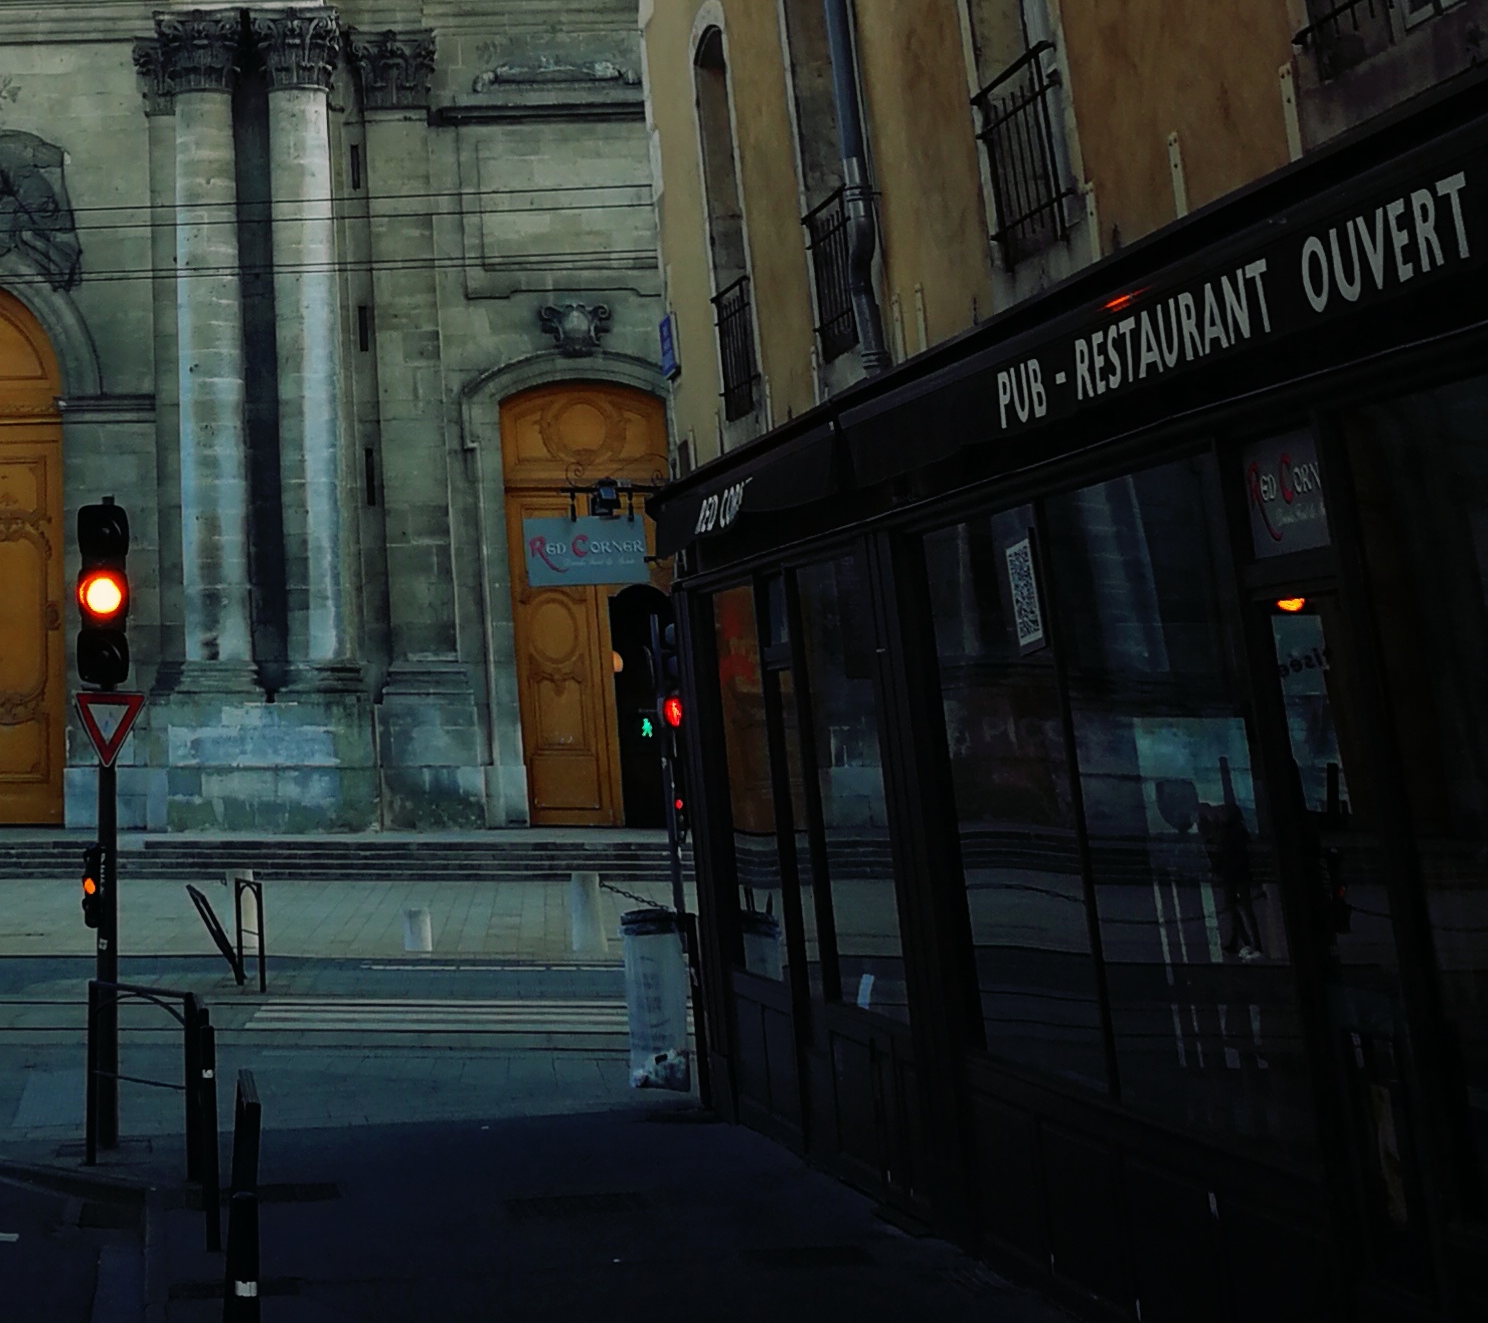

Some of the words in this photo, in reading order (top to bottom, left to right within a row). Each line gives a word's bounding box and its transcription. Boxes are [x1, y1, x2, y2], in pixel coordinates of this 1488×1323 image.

[996, 357, 1048, 430] PUB
[1074, 257, 1273, 401] RESTAURANT
[1300, 170, 1472, 314] OUVERT
[694, 493, 719, 535] RED
[571, 533, 645, 558] CORNER
